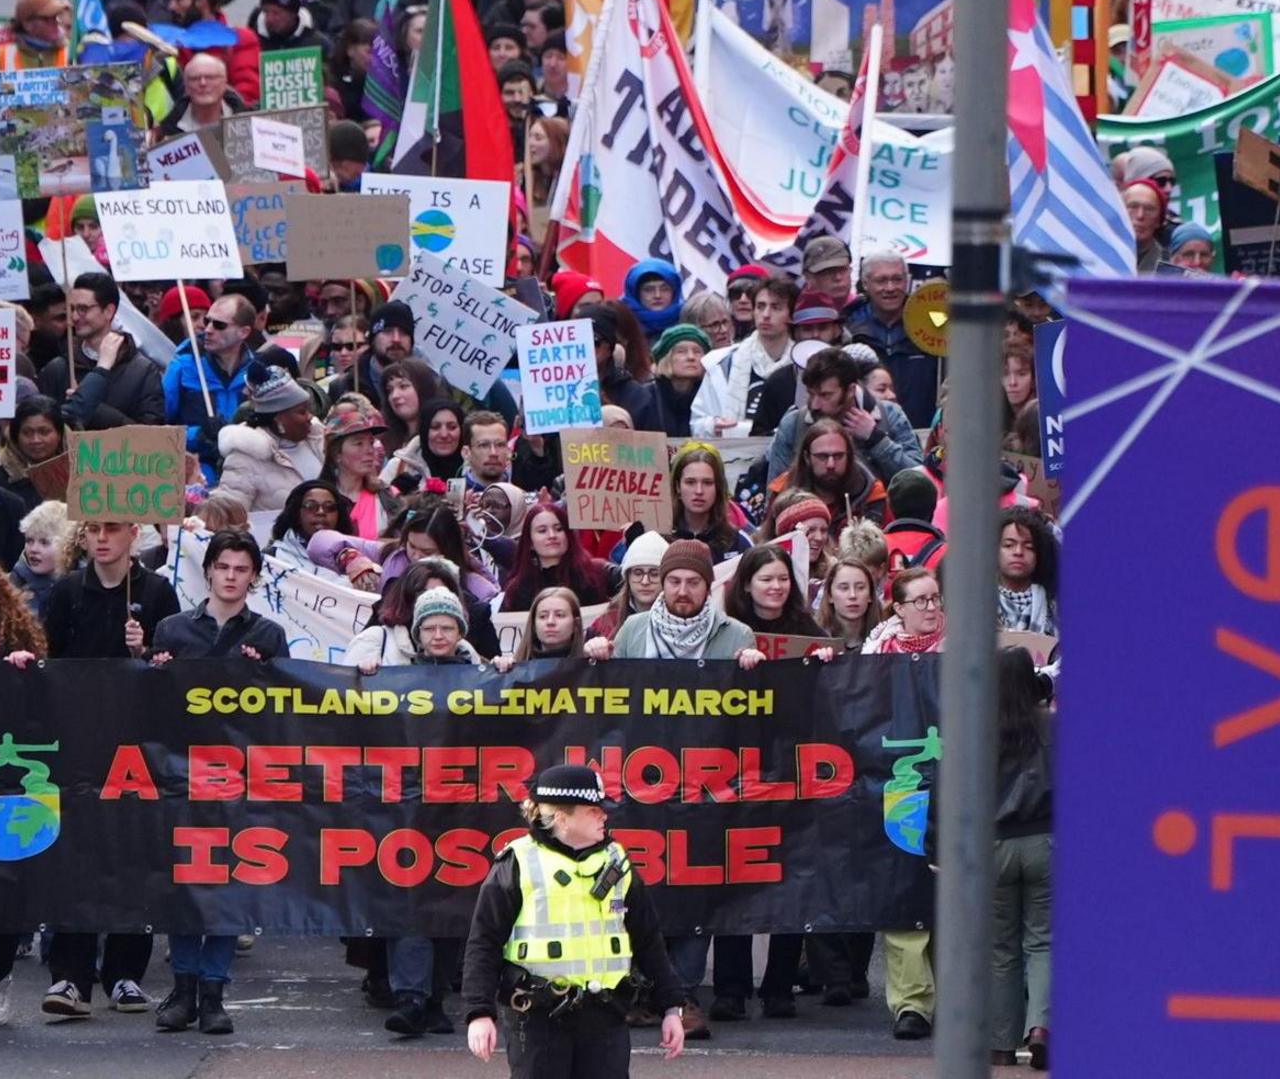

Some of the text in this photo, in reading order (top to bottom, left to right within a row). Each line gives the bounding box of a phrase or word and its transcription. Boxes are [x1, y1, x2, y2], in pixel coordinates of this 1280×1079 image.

[264, 58, 317, 75] NO NEW
[264, 74, 317, 91] FOSSIL
[265, 89, 318, 110] FUELS
[787, 105, 939, 171] CLIATE
[155, 142, 201, 167] WEALTH
[100, 197, 226, 216] MAKE SCOTLAND
[431, 190, 452, 208] IS
[469, 194, 481, 210] A
[779, 167, 930, 225] JUICE
[117, 238, 229, 261] COLD AGAIN
[449, 256, 494, 276] CASE
[531, 325, 577, 345] SAVE
[528, 343, 587, 365] EARTH
[529, 363, 587, 384] TODAY
[545, 383, 578, 403] FOR
[75, 438, 177, 479] Nature
[567, 442, 611, 464] SAFE
[575, 465, 664, 497] LIVEABLE
[78, 480, 178, 518] BLOC
[577, 494, 663, 525] PLANET
[186, 686, 774, 716] SCOTLAND'S CLIMATE MARCH
[99, 745, 159, 801] A
[187, 744, 536, 804] BETTER
[172, 825, 783, 888] IS POSBLE
